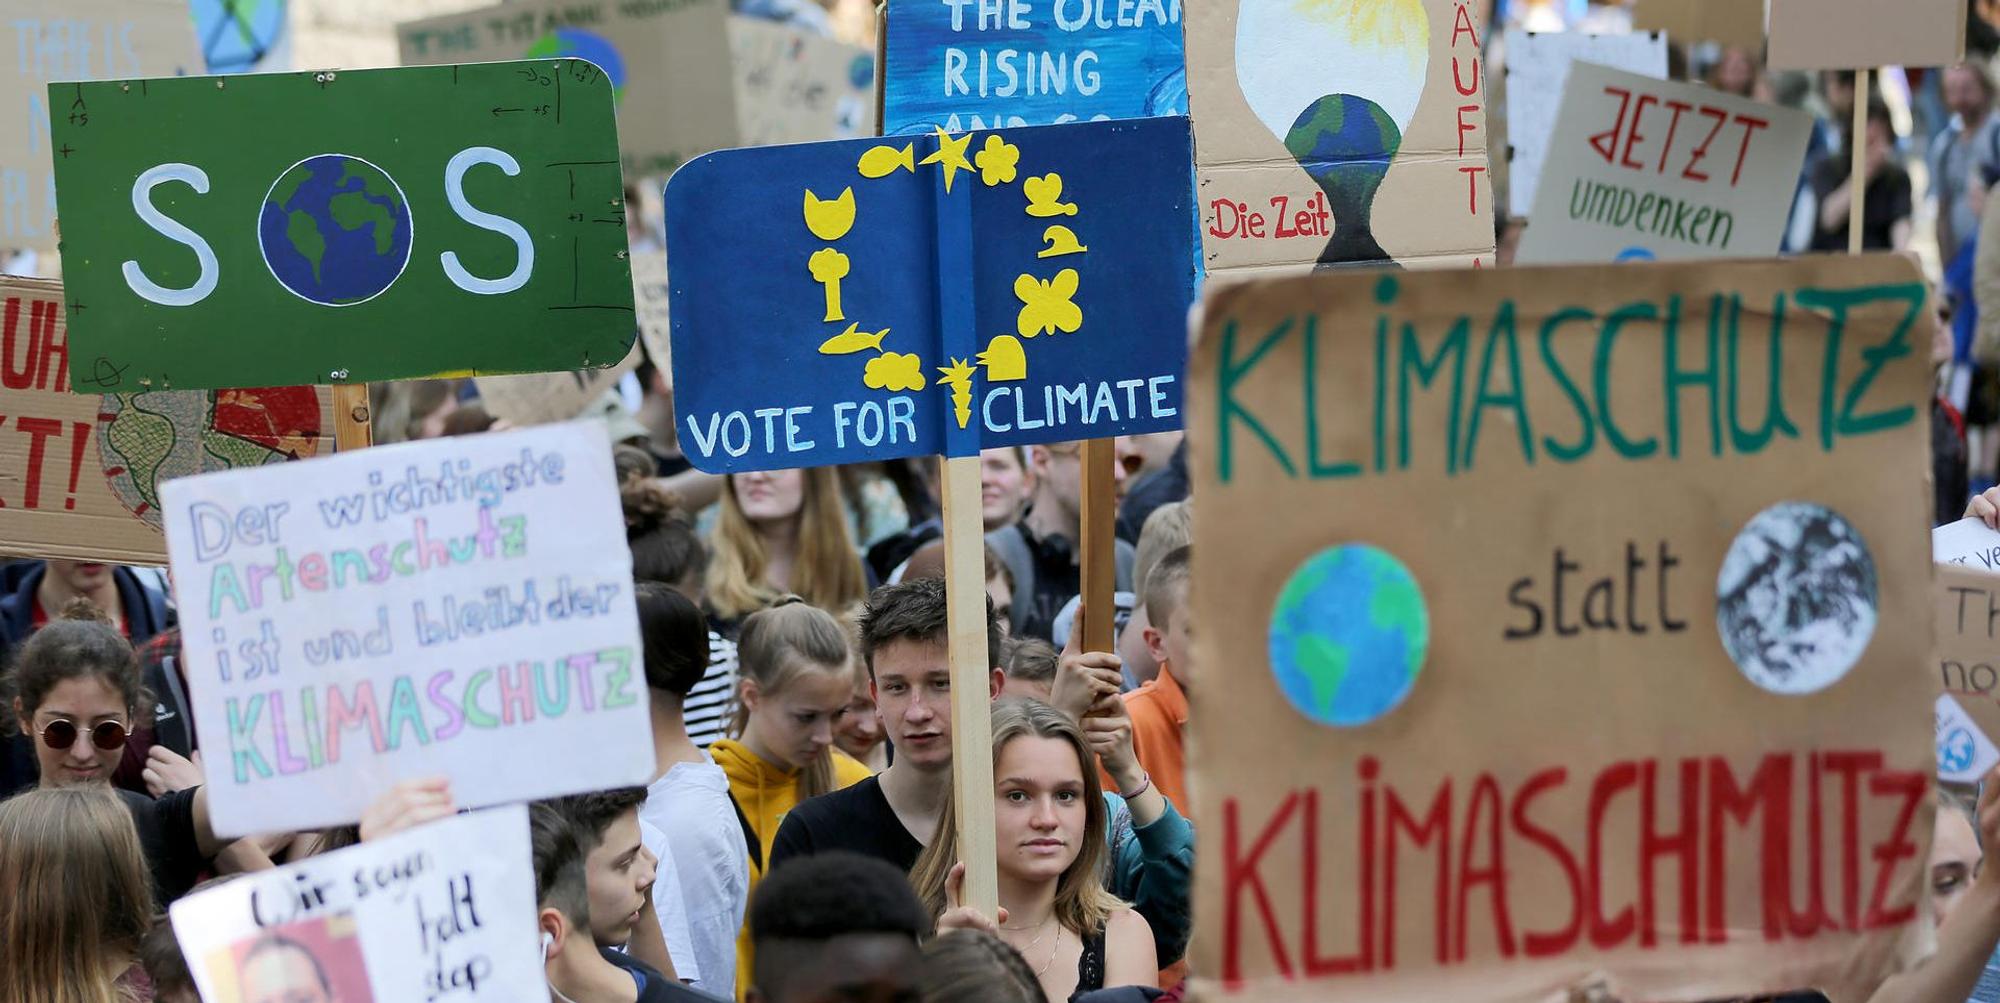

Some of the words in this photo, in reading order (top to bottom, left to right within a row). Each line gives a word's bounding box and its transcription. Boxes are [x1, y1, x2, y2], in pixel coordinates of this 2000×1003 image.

[942, 0, 1032, 31] THE
[944, 48, 1101, 98] RISING
[1588, 86, 1769, 188] JETZT
[1210, 198, 1266, 239] Die
[1270, 191, 1330, 239] Zeit
[1, 297, 71, 393] UH
[0, 415, 92, 510] T!
[687, 406, 816, 458] VOTE
[834, 395, 917, 449] FOR
[982, 374, 1178, 434] CLIMATE
[189, 502, 290, 563] Der
[319, 448, 566, 528] wichtigste
[209, 504, 527, 620] Artenschutz
[1503, 540, 1688, 641] statt
[212, 618, 283, 683] ist
[303, 605, 393, 666] und
[546, 574, 621, 621] der
[224, 646, 638, 784] KLIMASCHUTZ
[251, 873, 336, 928] Wir
